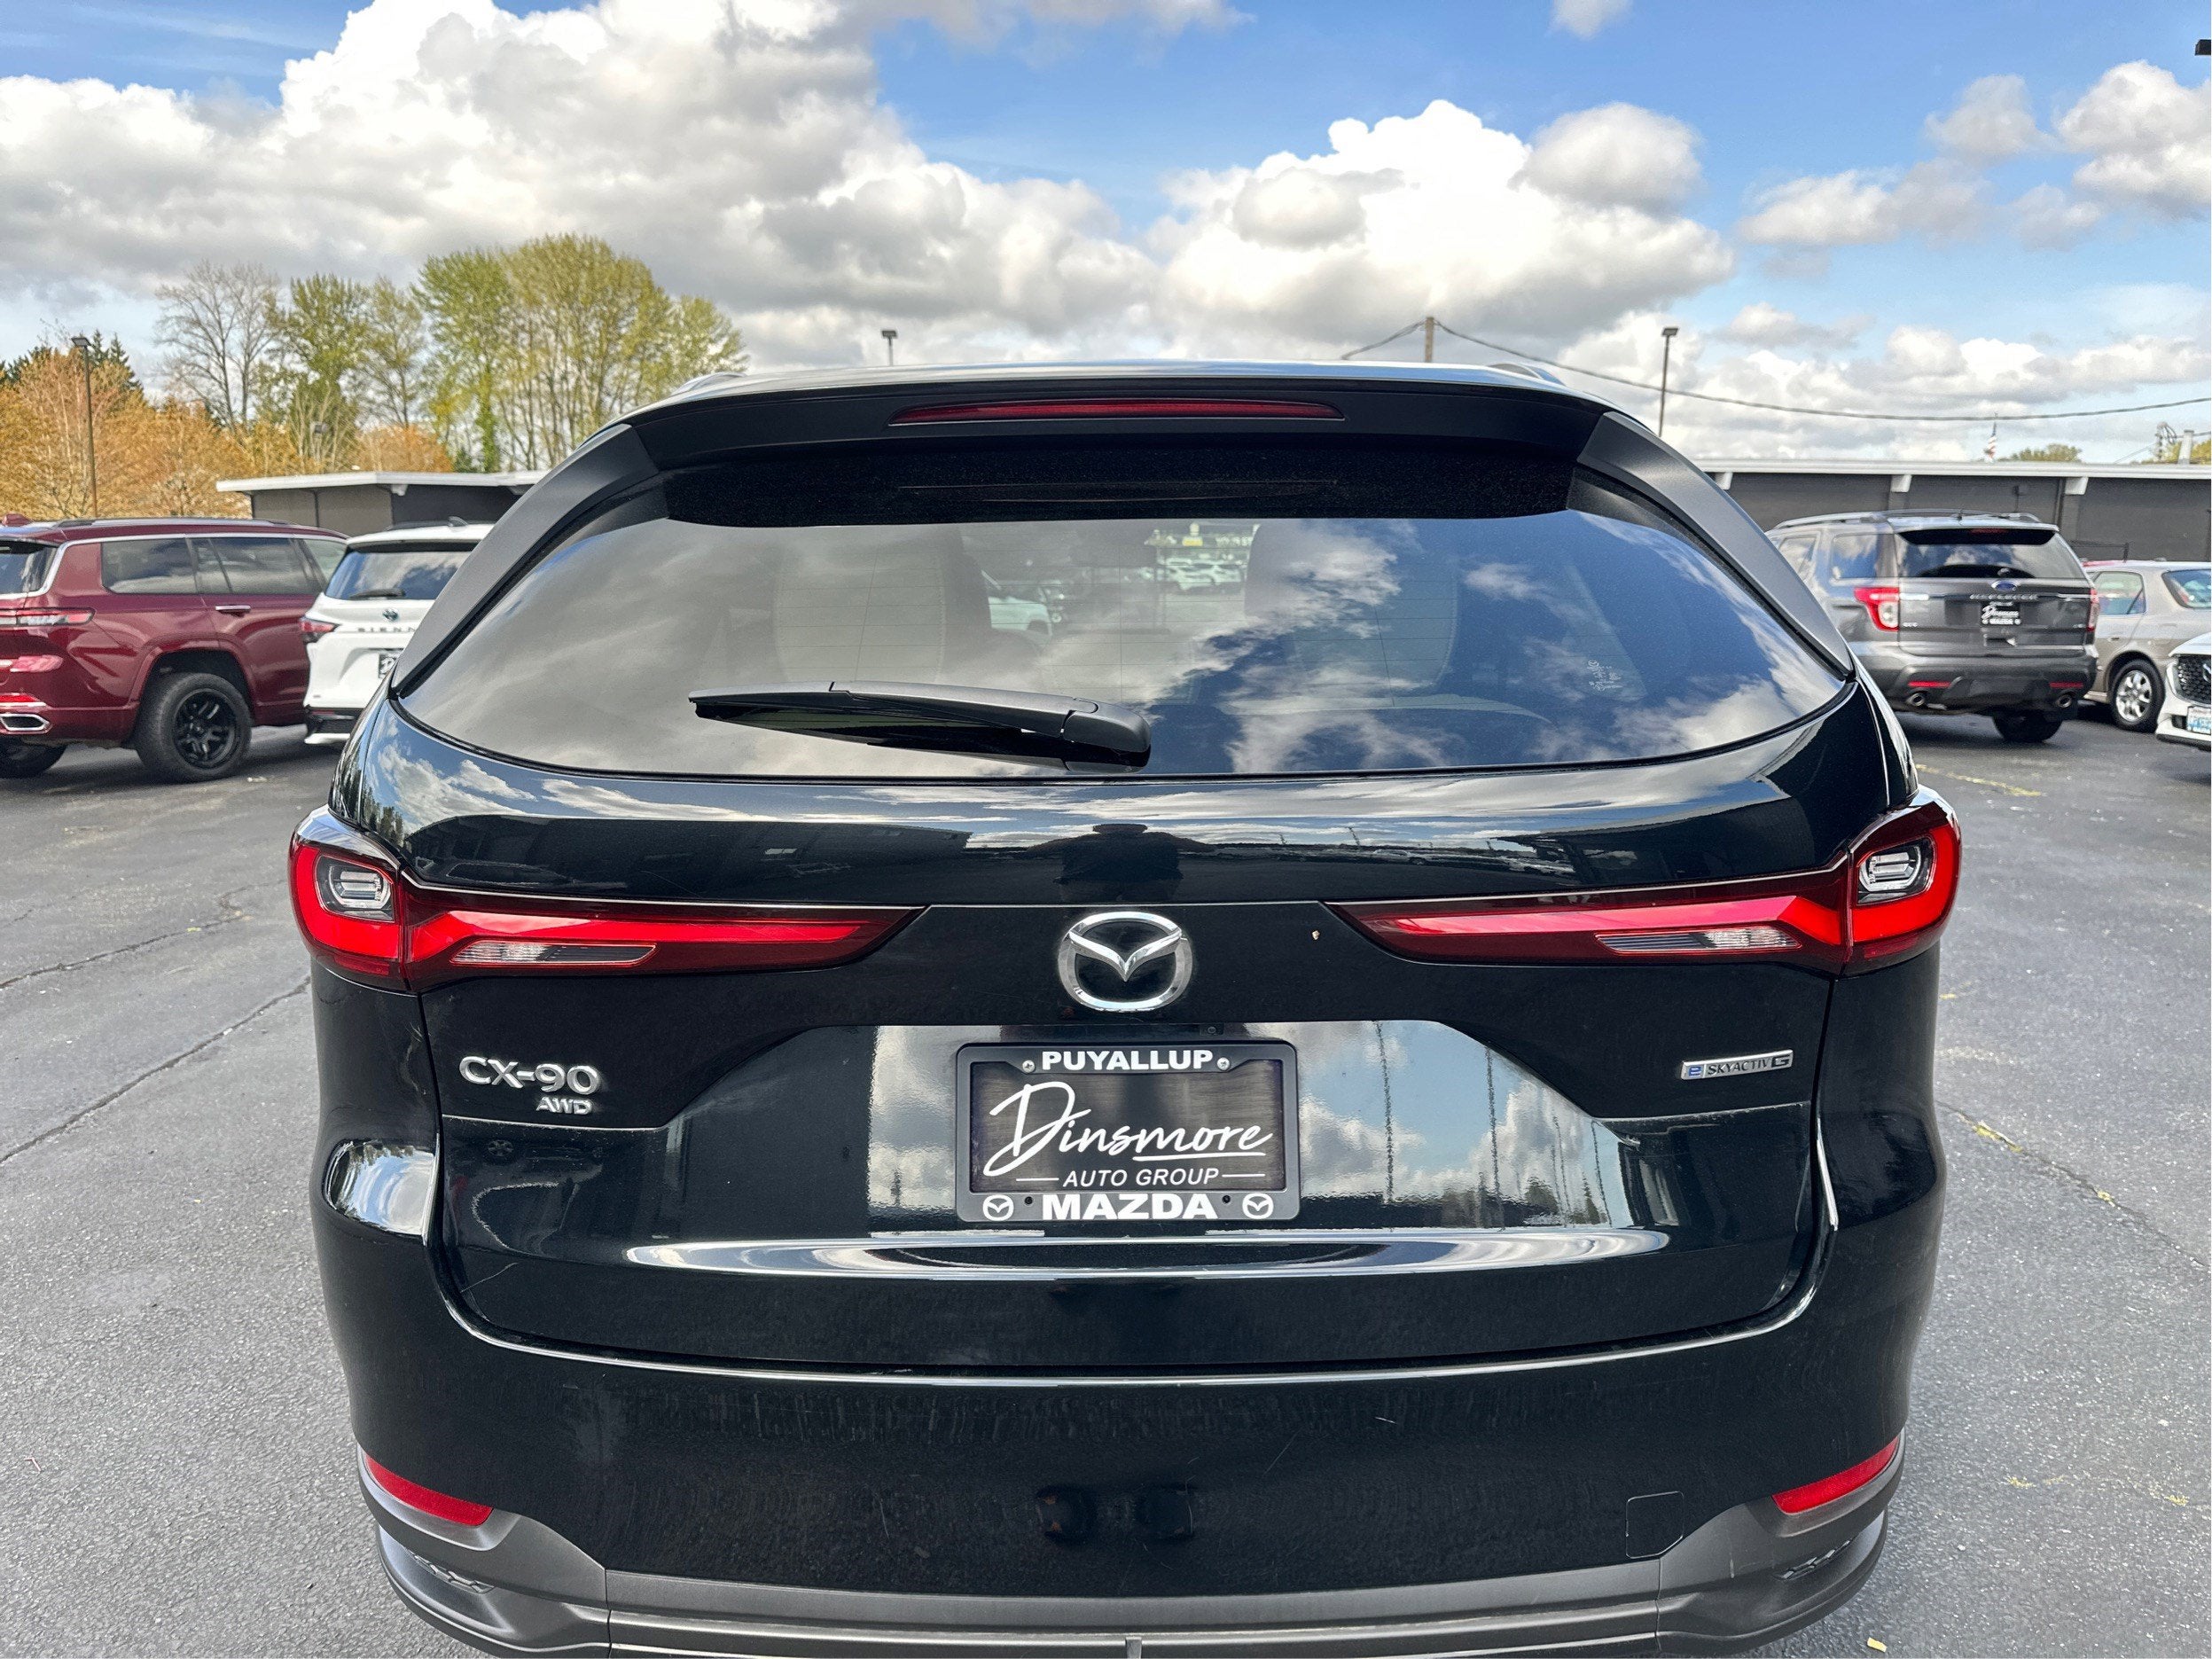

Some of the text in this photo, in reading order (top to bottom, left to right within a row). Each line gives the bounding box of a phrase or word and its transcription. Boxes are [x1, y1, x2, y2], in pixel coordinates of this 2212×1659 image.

[1042, 1050, 1214, 1071] PUYALLUP
[1708, 1058, 1770, 1076] SKYACTIV
[459, 1056, 601, 1095] CX-90
[535, 1096, 595, 1115] AWD
[982, 1081, 1273, 1178] Dinsmore
[1062, 1167, 1219, 1187] AUTO GROUP
[1042, 1193, 1218, 1220] MAZDA
